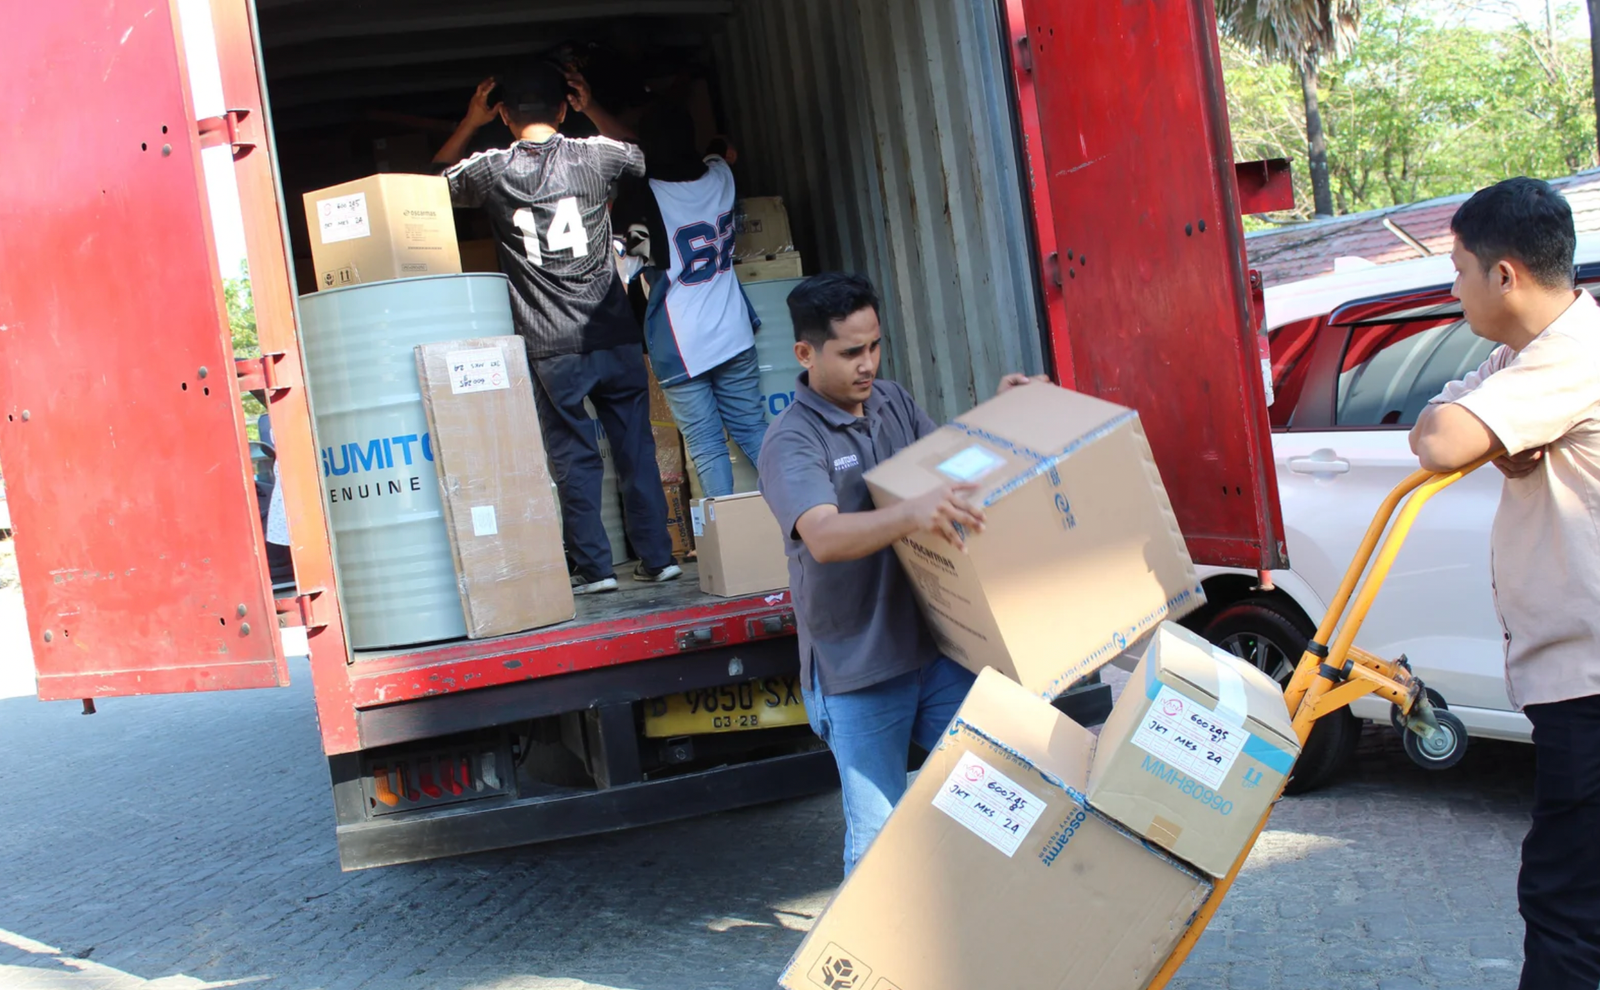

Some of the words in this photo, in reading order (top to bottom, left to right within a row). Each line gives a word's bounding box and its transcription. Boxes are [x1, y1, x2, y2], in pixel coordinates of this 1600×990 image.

[512, 196, 590, 266] 14
[764, 678, 799, 707] SX
[962, 728, 985, 745] heavy
[989, 744, 1032, 772] equipment
[1149, 720, 1168, 734] JKT
[1175, 736, 1197, 751] MKS
[949, 784, 970, 800] JKT
[973, 802, 995, 817] MKS
[1141, 755, 1233, 816] MMH80990
